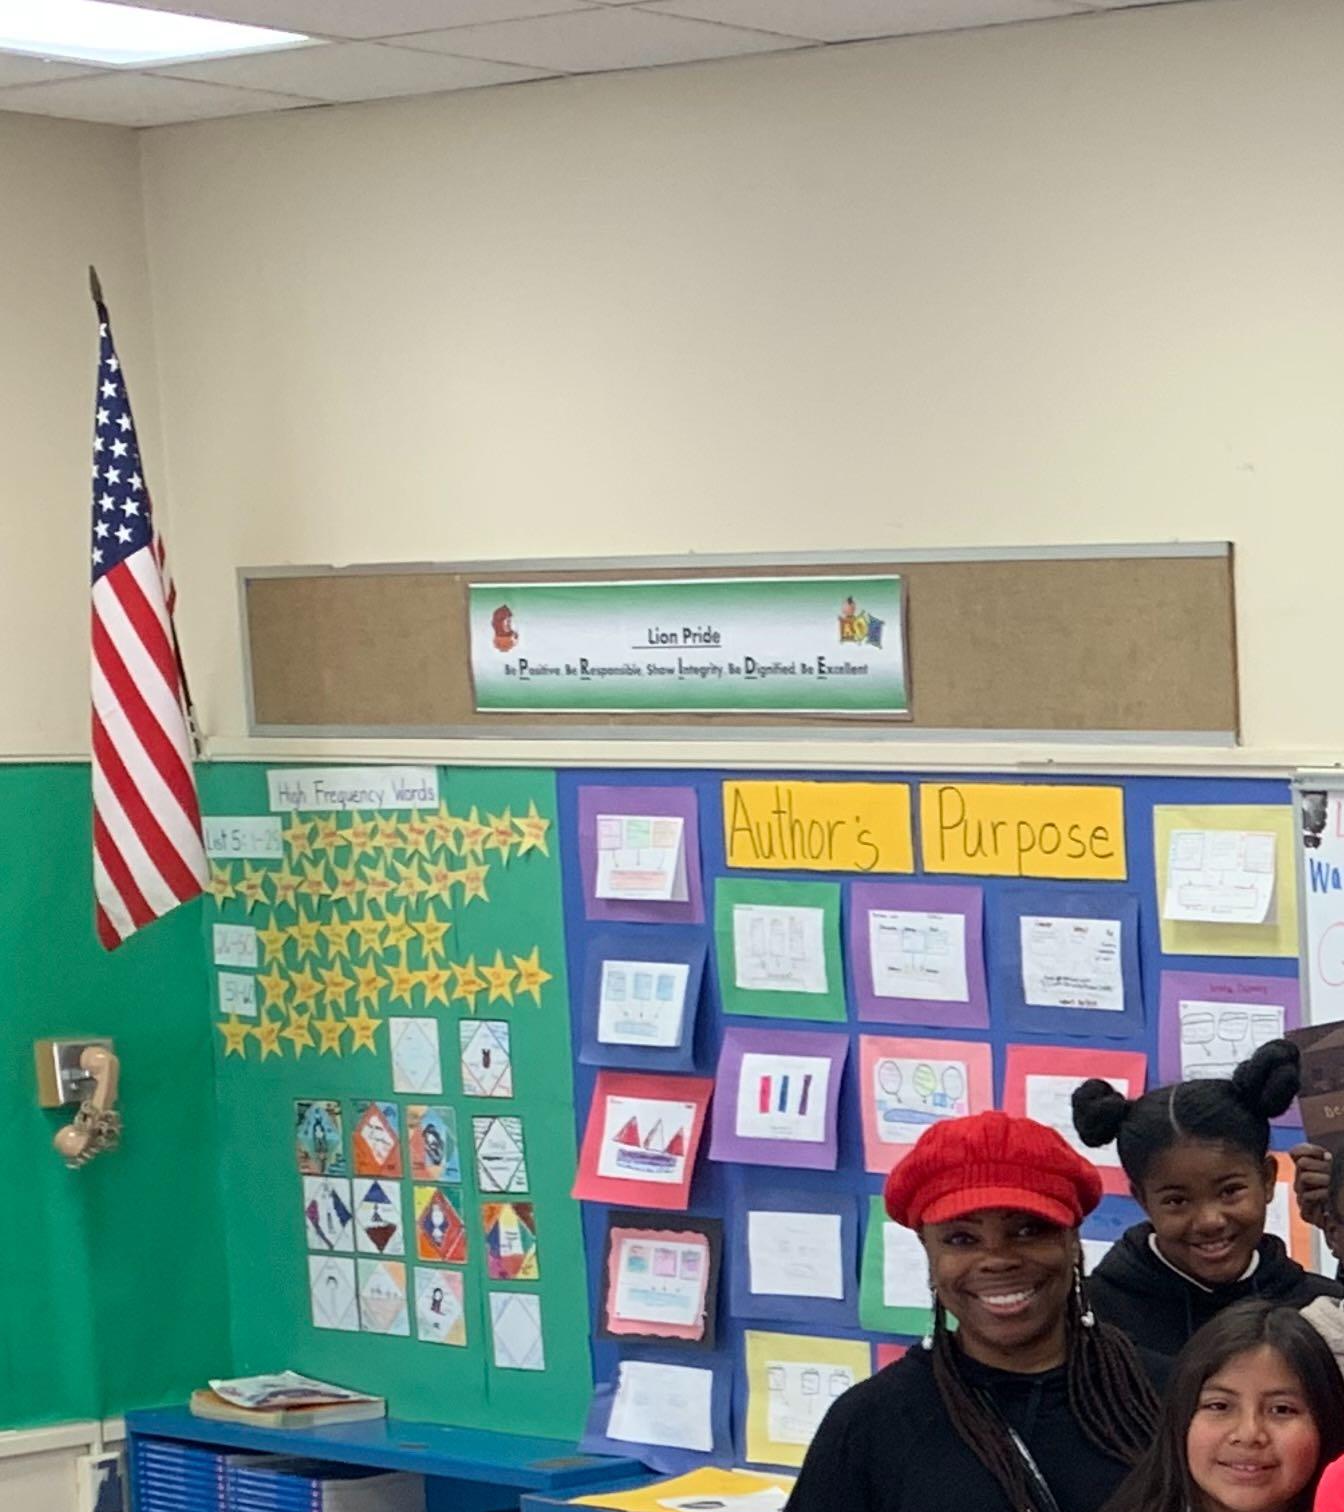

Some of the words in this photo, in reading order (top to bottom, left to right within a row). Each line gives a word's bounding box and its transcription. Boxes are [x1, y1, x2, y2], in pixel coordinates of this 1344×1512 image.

[648, 627, 678, 645] Lion
[682, 627, 721, 646] Pride
[279, 780, 307, 808] High
[313, 780, 384, 810] Frequency
[392, 777, 434, 802] Words
[729, 786, 880, 872] Author's
[938, 785, 1114, 877] Purpose
